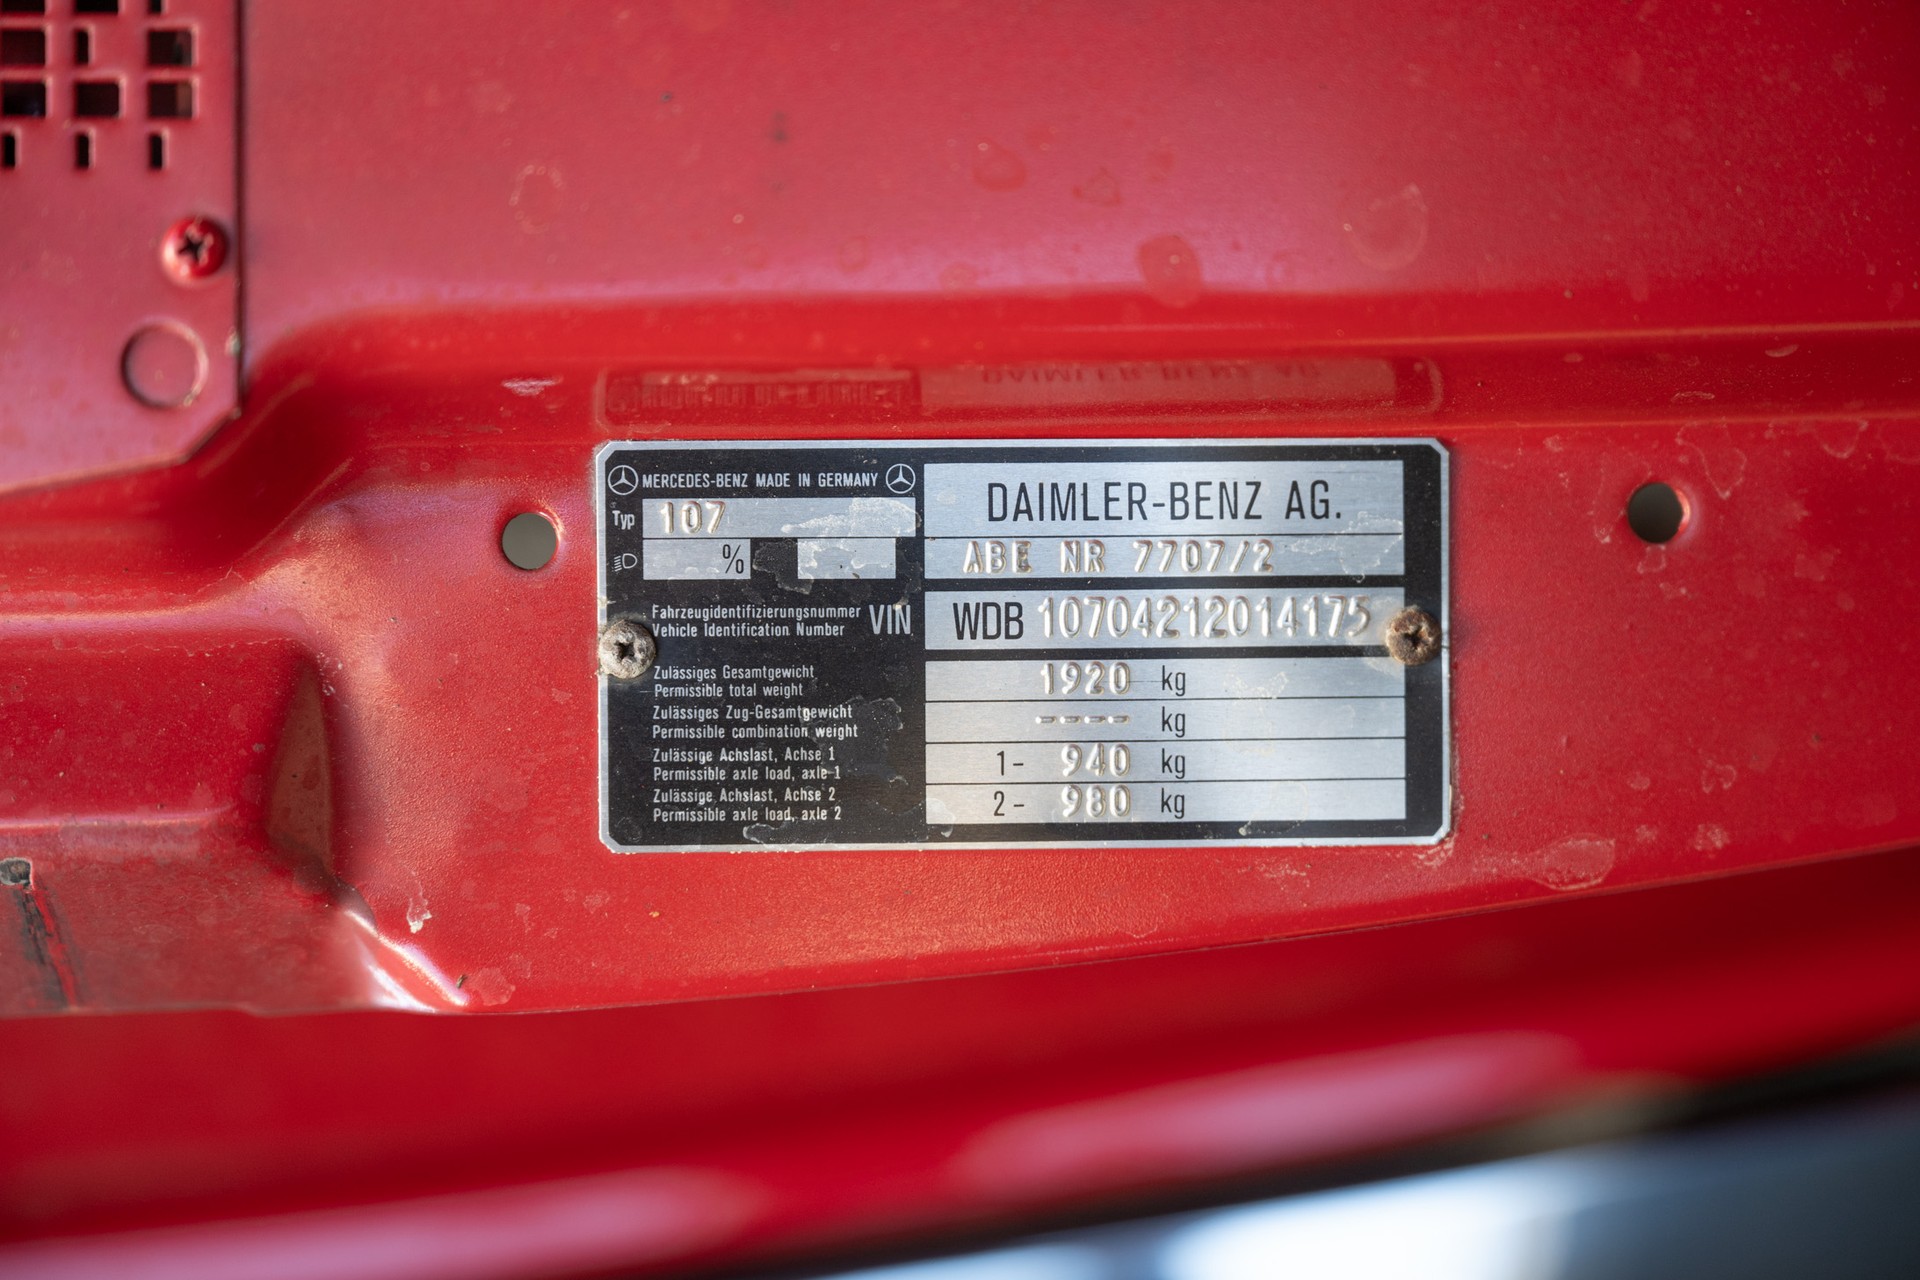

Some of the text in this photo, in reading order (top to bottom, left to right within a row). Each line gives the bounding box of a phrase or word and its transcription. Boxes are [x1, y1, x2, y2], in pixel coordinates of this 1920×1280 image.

[642, 473, 878, 488] MERCEDES-BENZ MADE IN GERMANY
[987, 480, 1341, 522] DAIMLER-BENZ AG.
[612, 510, 635, 530] Typ
[660, 501, 727, 534] 107
[722, 544, 744, 574] %
[962, 539, 1275, 574] ABE NR 7707/2
[652, 604, 861, 620] Fahrzeugidentifizierungsnummer
[869, 604, 911, 635] VIN
[953, 594, 1372, 641] WDB 10704212014175
[652, 622, 845, 637] Vehicle Identification Number
[654, 665, 815, 681] Zulässiges Gesamtgewicht
[1040, 661, 1186, 696] 1920 kg
[655, 683, 803, 699] Permissible total weight
[653, 705, 853, 721] Zulässiges Zug-Gesamtgewicht
[1161, 707, 1186, 738] kg
[652, 724, 858, 740] Permissible combination weight
[653, 747, 835, 764] Zulässige Achslast, Achse 1
[1060, 744, 1132, 778] 940
[1161, 748, 1186, 779] kg
[654, 766, 840, 782] Permissible axle load, axle 1
[653, 788, 835, 804] Zulässige Achslast, Achse 2
[1060, 784, 1132, 817] 980
[1161, 788, 1186, 819] kg
[653, 807, 841, 822] Permissible axle load, axle 2
